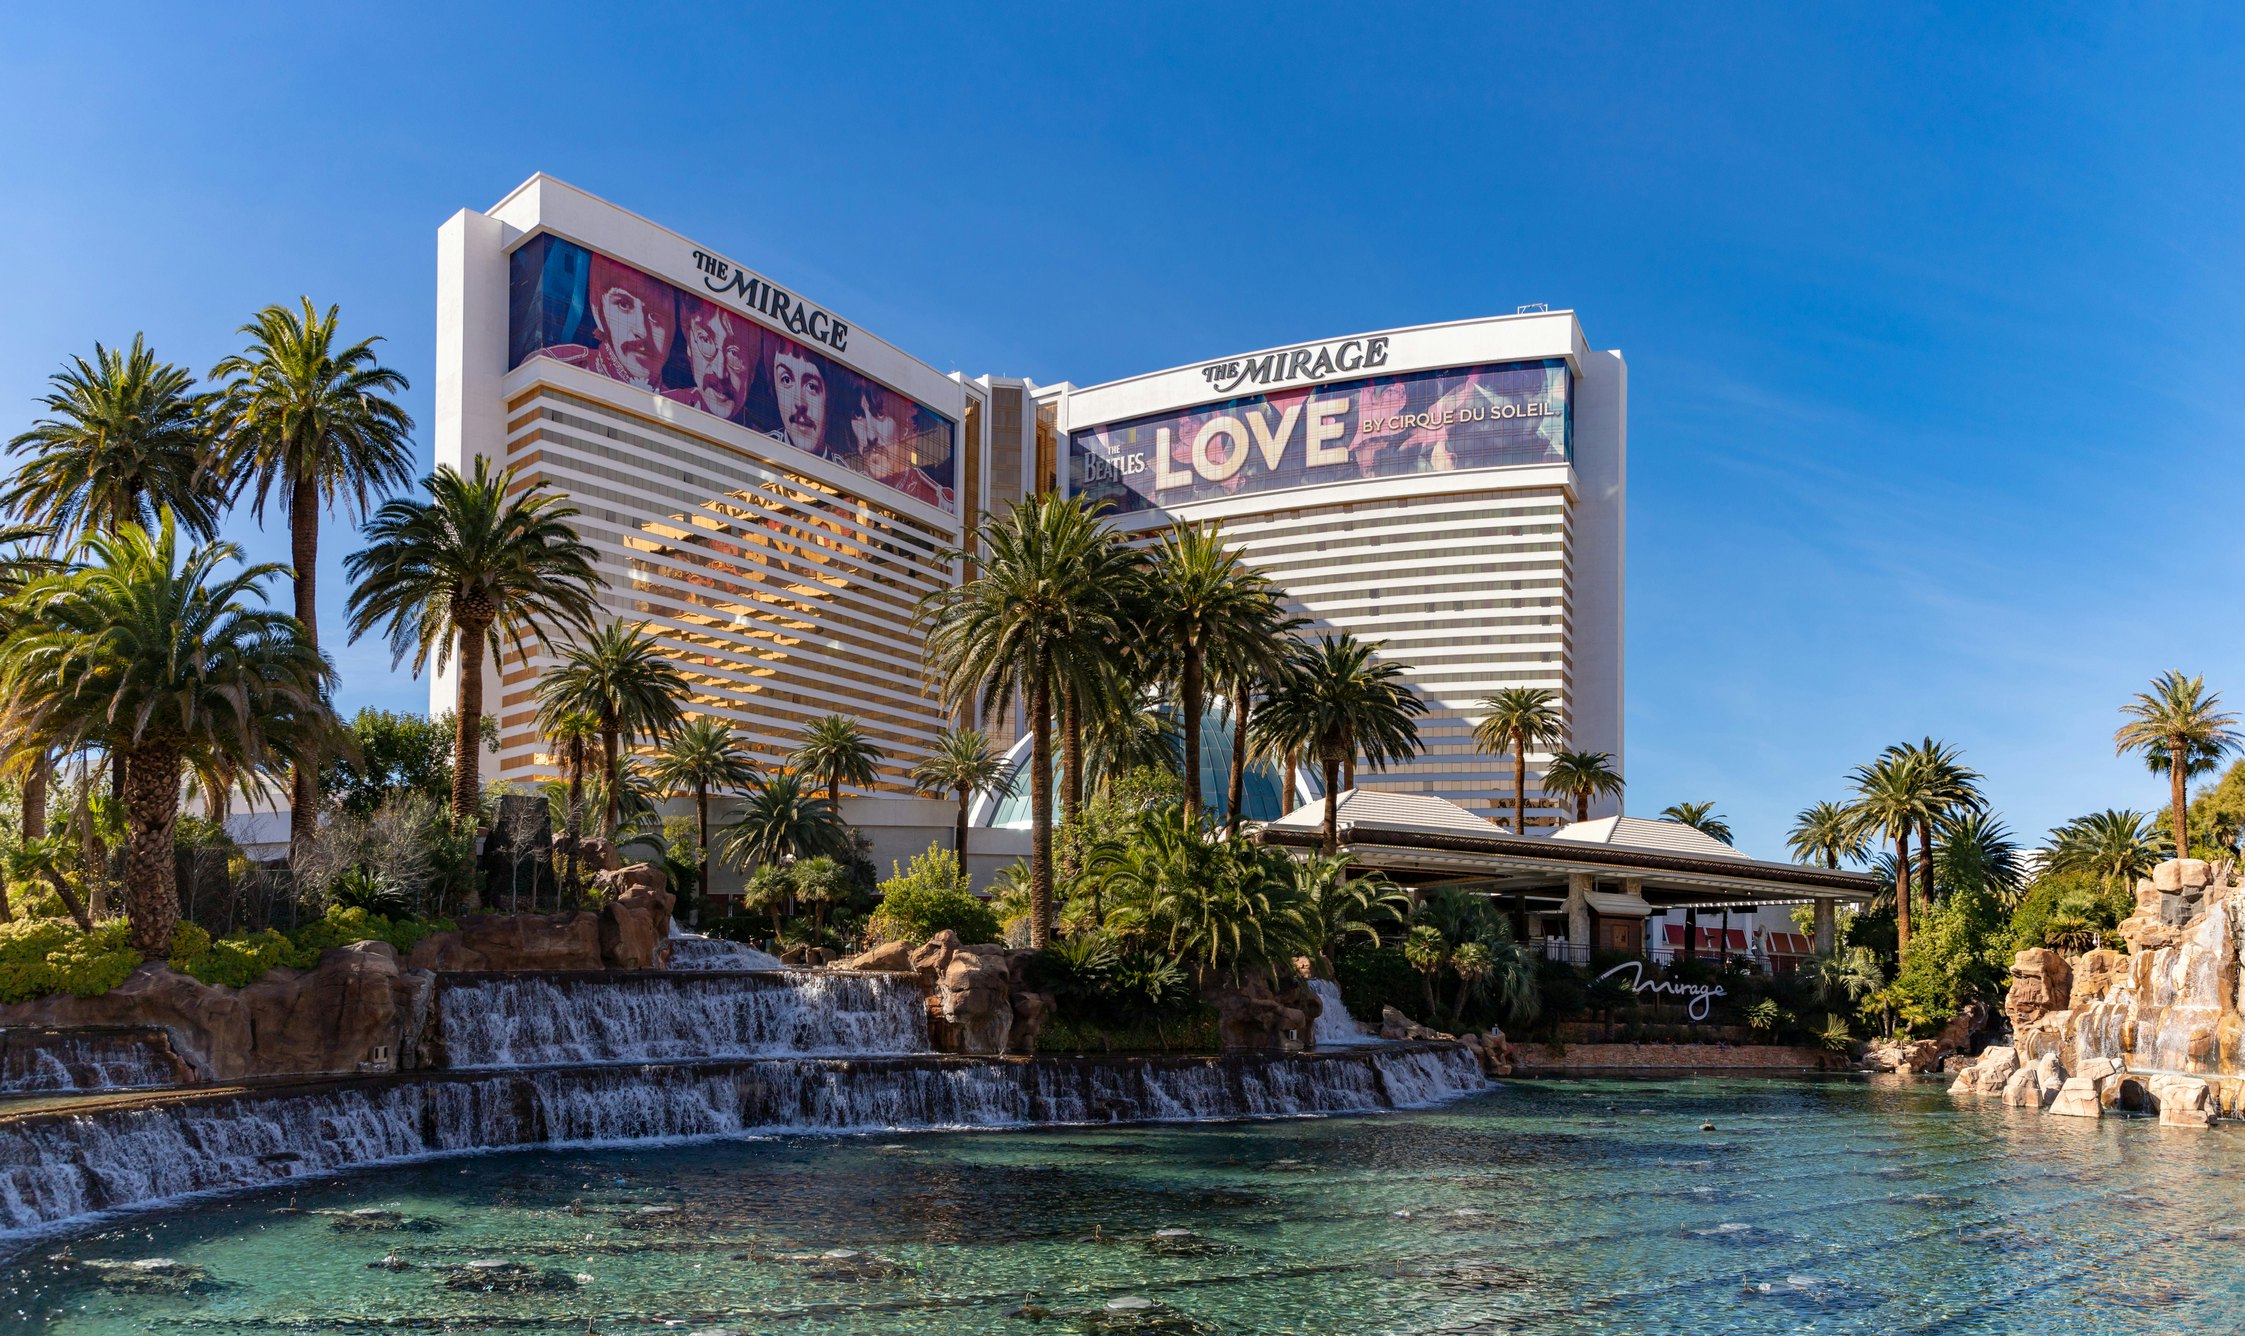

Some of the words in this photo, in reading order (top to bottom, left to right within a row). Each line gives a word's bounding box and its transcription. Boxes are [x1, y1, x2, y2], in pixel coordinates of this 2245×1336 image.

[692, 250, 729, 281] THE
[704, 269, 849, 353] MIRAGE
[1202, 361, 1240, 383] THE
[1213, 337, 1390, 393] MIRAGE
[1363, 418, 1384, 433] BY
[1388, 410, 1455, 430] CIRQUE
[1459, 407, 1485, 423] DU
[1108, 445, 1121, 455] THE
[1155, 397, 1350, 491] LOVE
[1084, 452, 1146, 483] BEATLES
[1588, 961, 1728, 1021] Mirage
